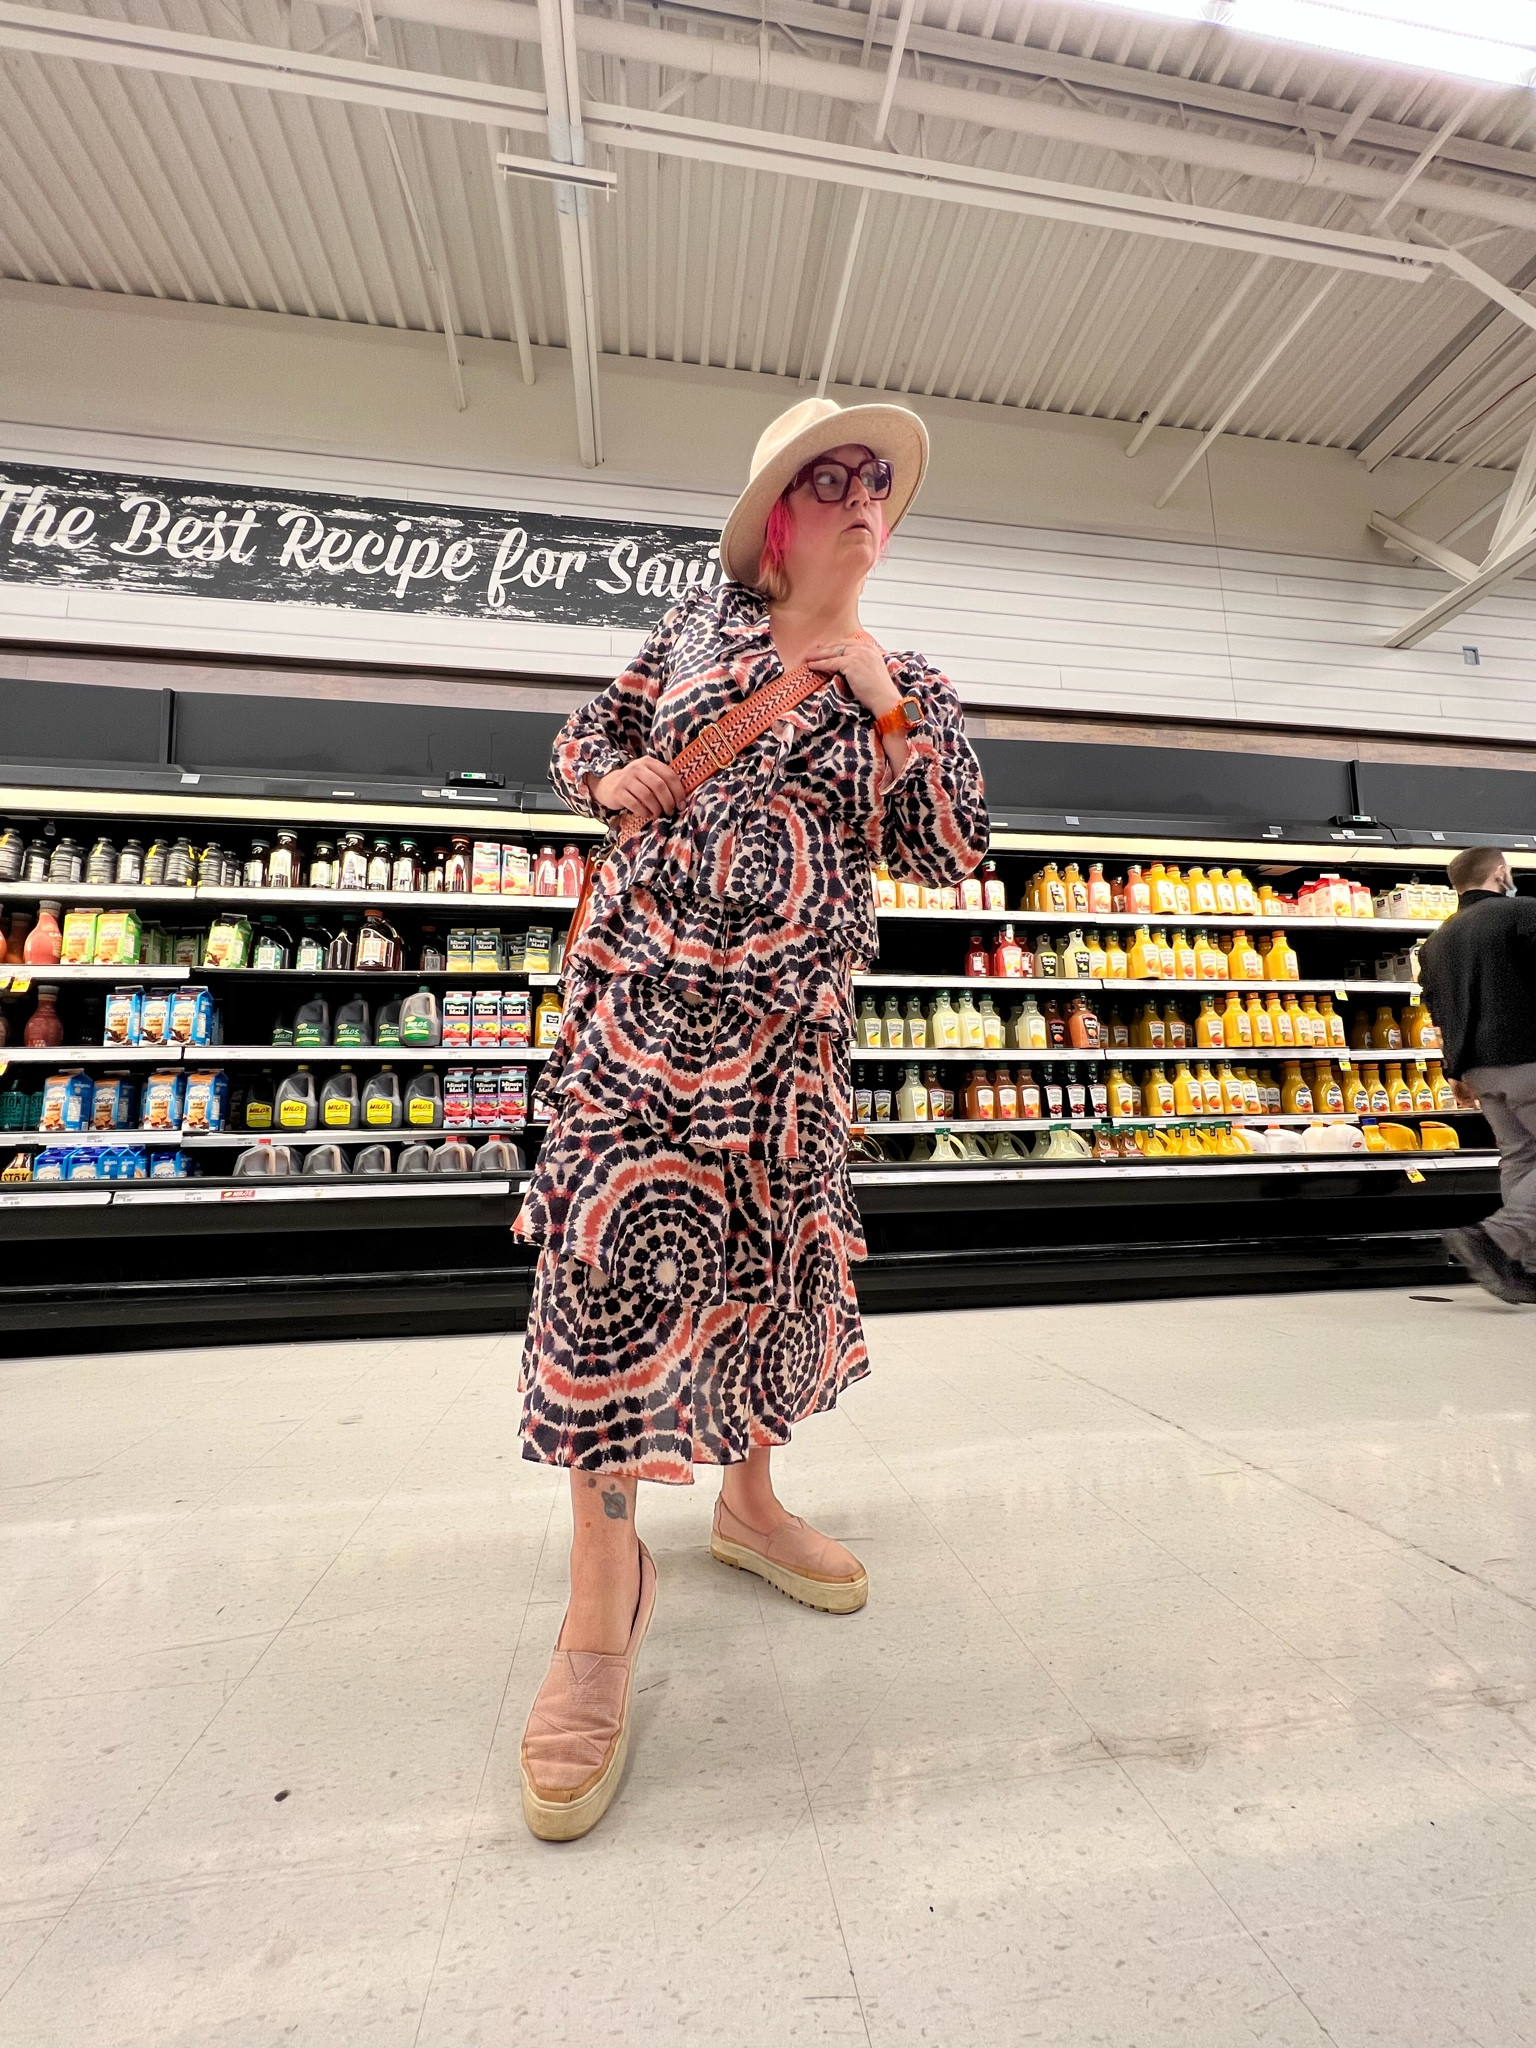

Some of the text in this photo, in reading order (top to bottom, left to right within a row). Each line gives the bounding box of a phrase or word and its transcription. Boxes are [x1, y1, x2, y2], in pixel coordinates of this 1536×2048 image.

[0, 484, 97, 549] The
[110, 496, 262, 563] Best
[277, 511, 478, 599] Recipe
[487, 527, 587, 607] for
[45, 1095, 66, 1103] delight
[93, 1096, 116, 1104] delight
[149, 1093, 172, 1101] delight
[187, 1093, 210, 1101] delight
